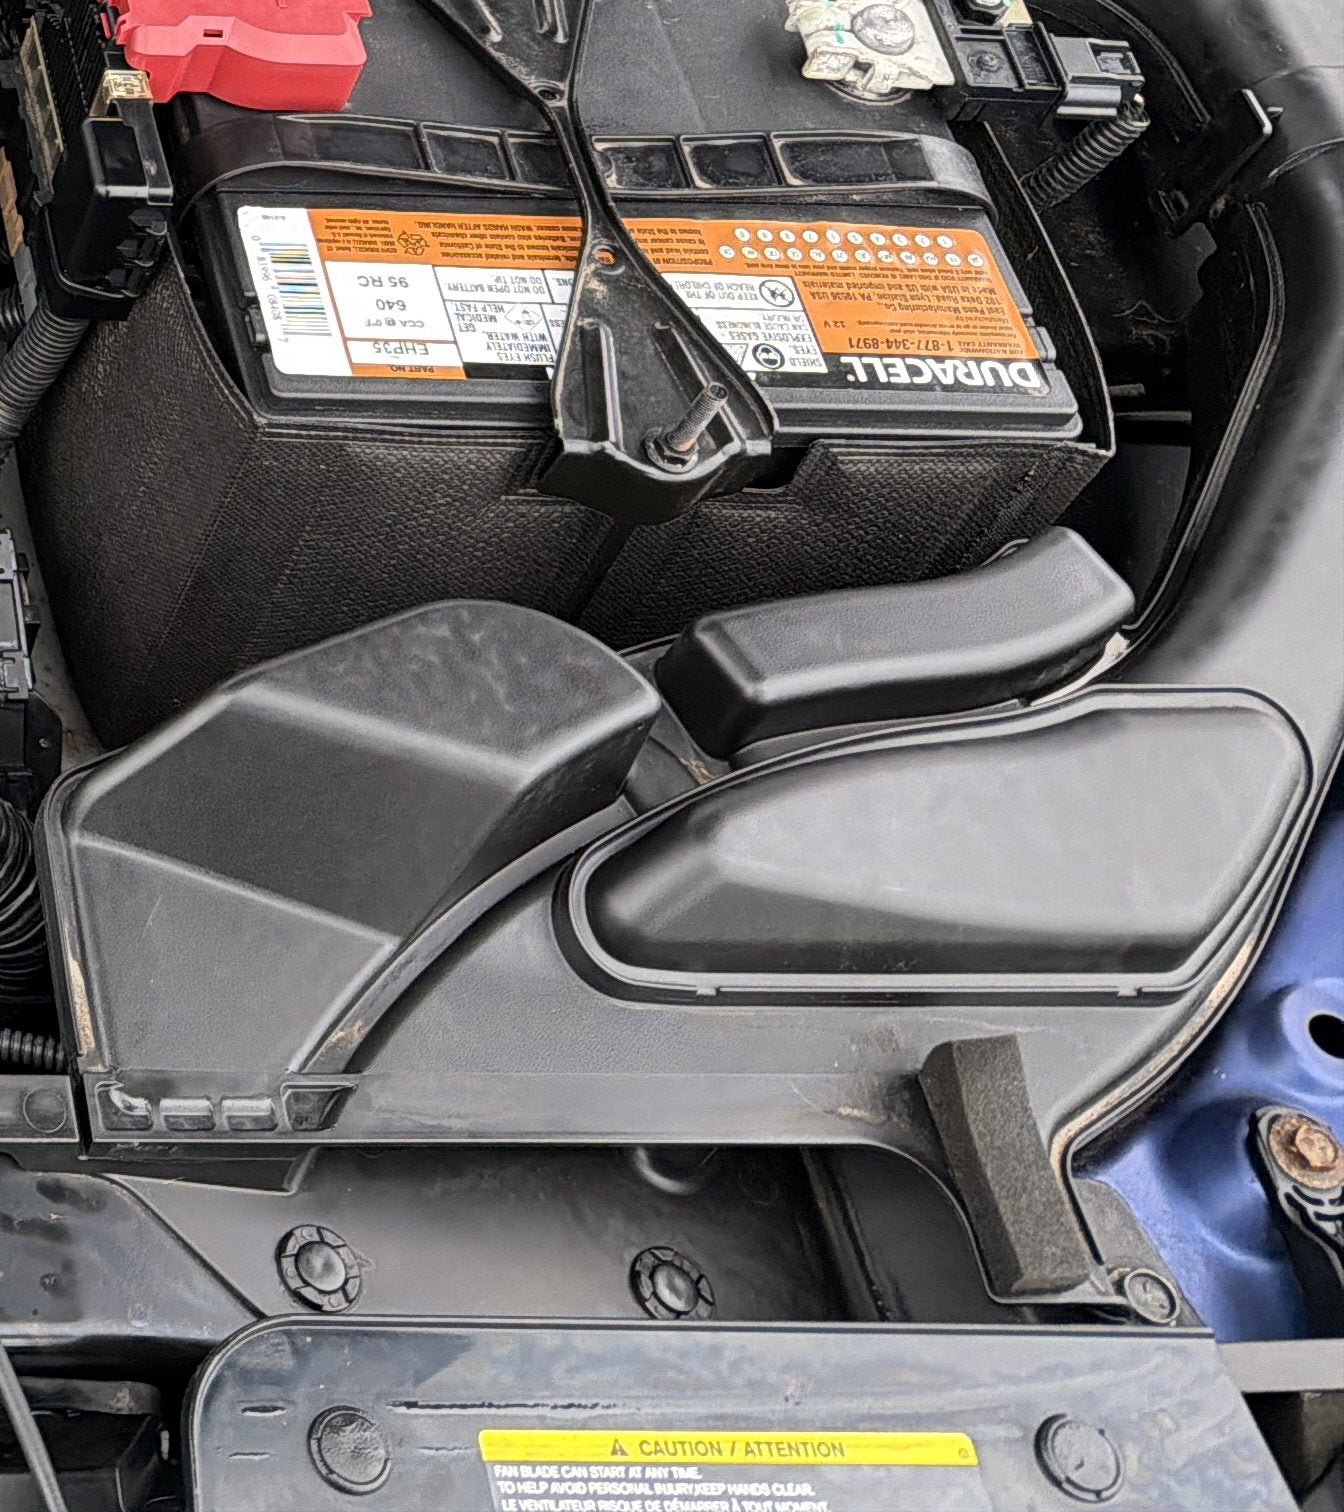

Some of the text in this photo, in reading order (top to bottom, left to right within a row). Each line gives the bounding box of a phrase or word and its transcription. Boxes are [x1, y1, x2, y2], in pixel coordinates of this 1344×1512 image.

[662, 257, 713, 266] PROPOSITION
[357, 275, 409, 288] 95 RC
[803, 280, 843, 289] materials
[847, 281, 884, 290] imported
[887, 283, 902, 291] and
[905, 284, 917, 292] US
[921, 284, 939, 293] with
[942, 285, 960, 294] USA
[962, 286, 970, 294] in
[809, 291, 828, 299] USA
[859, 292, 871, 301] PA
[375, 299, 406, 311] 640
[481, 304, 505, 313] HELP
[898, 304, 960, 314] Manufacturing
[962, 306, 985, 315] Penn
[987, 307, 1004, 315] East
[453, 313, 497, 323] MEDICAL
[400, 320, 424, 328] CCA
[459, 323, 476, 332] GET
[823, 320, 830, 328] V
[833, 320, 846, 328] 12
[523, 332, 547, 342] WITH
[762, 332, 812, 342] EXPLOSIVE
[372, 341, 429, 356] EHP35
[485, 342, 551, 352] IMMEDIATELY
[848, 337, 954, 351] 1-877-344-8971
[497, 352, 554, 362] FLUSH EYES
[789, 357, 822, 367] SHIELD
[840, 355, 1042, 388] DURACELL
[638, 1439, 723, 1457] CAUTION
[743, 1440, 846, 1458] ATTENTION
[494, 1465, 518, 1479] FAN
[520, 1465, 559, 1479] BLADE
[561, 1465, 587, 1479] CAN
[589, 1465, 626, 1479] START
[628, 1465, 642, 1479] AT
[645, 1465, 672, 1479] ANY
[497, 1481, 515, 1495] TO
[517, 1481, 549, 1495] HELP
[550, 1481, 587, 1495] AVOID
[588, 1481, 654, 1495] PERSONAL
[728, 1481, 770, 1496] HANDS
[502, 1500, 518, 1512] LE
[519, 1500, 596, 1512] VENTILATEUR
[598, 1501, 643, 1512] RISQUE
[645, 1501, 663, 1512] DE
